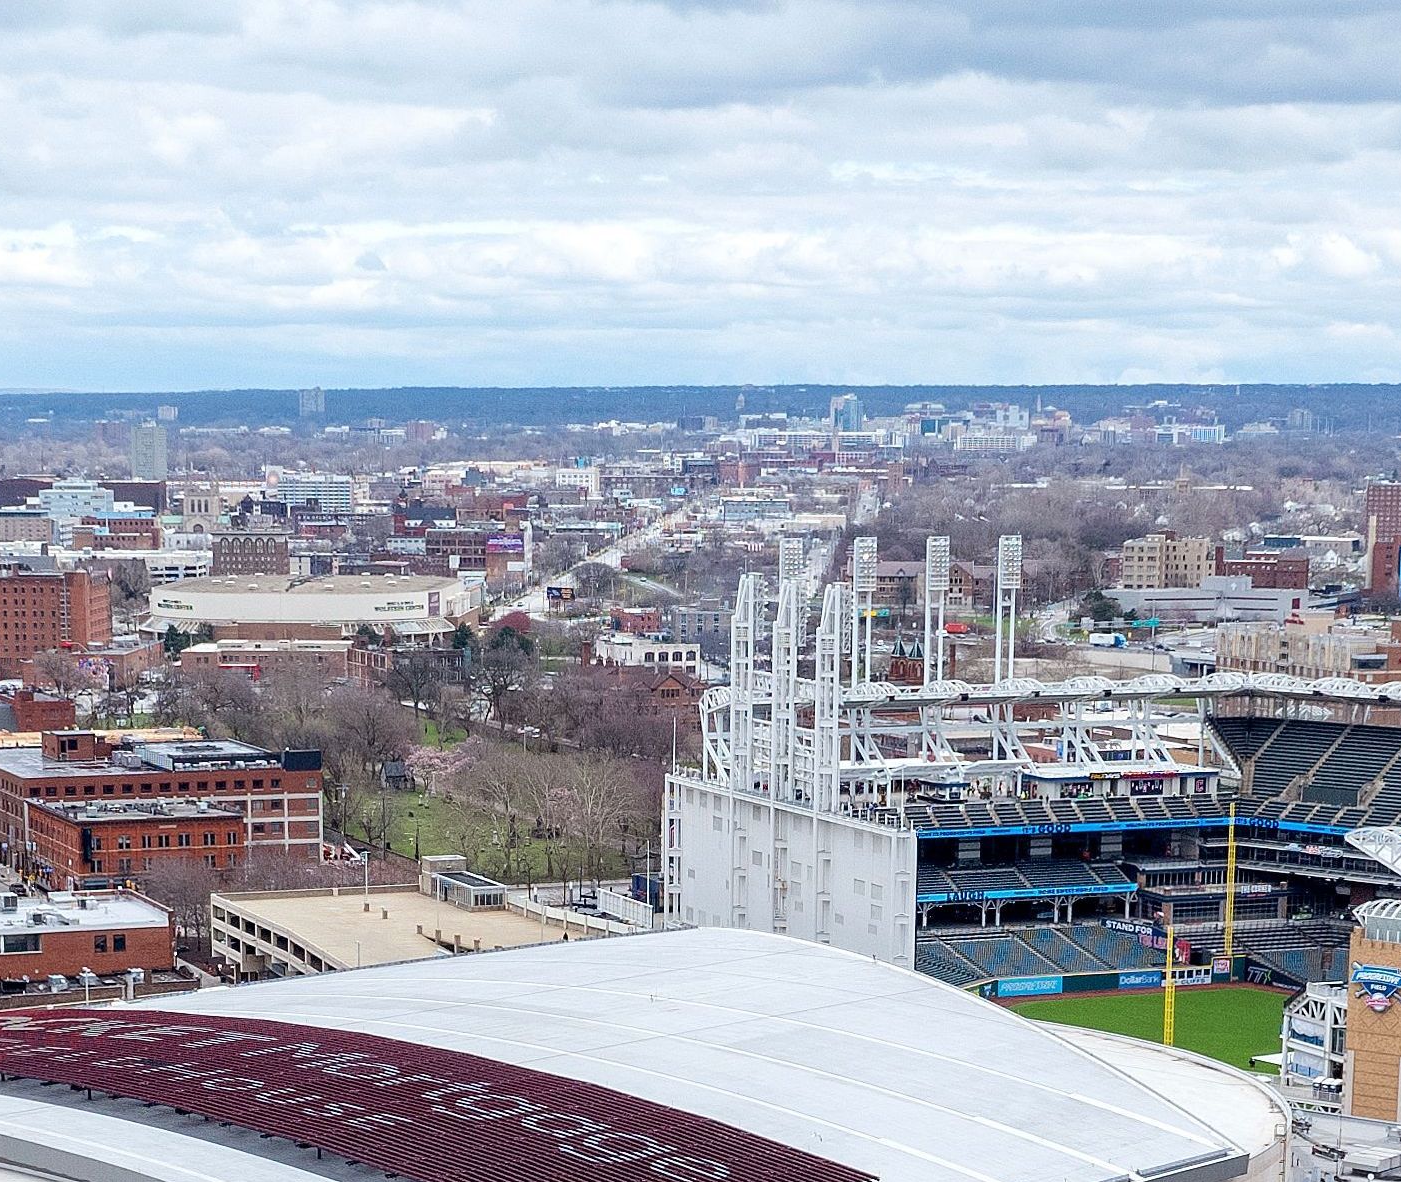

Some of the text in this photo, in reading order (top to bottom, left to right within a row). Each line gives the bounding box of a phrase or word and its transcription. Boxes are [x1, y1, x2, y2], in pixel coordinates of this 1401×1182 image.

[1248, 817, 1280, 829] GOOD
[1038, 824, 1072, 835] GOOD
[1105, 919, 1153, 935] STAND FOR
